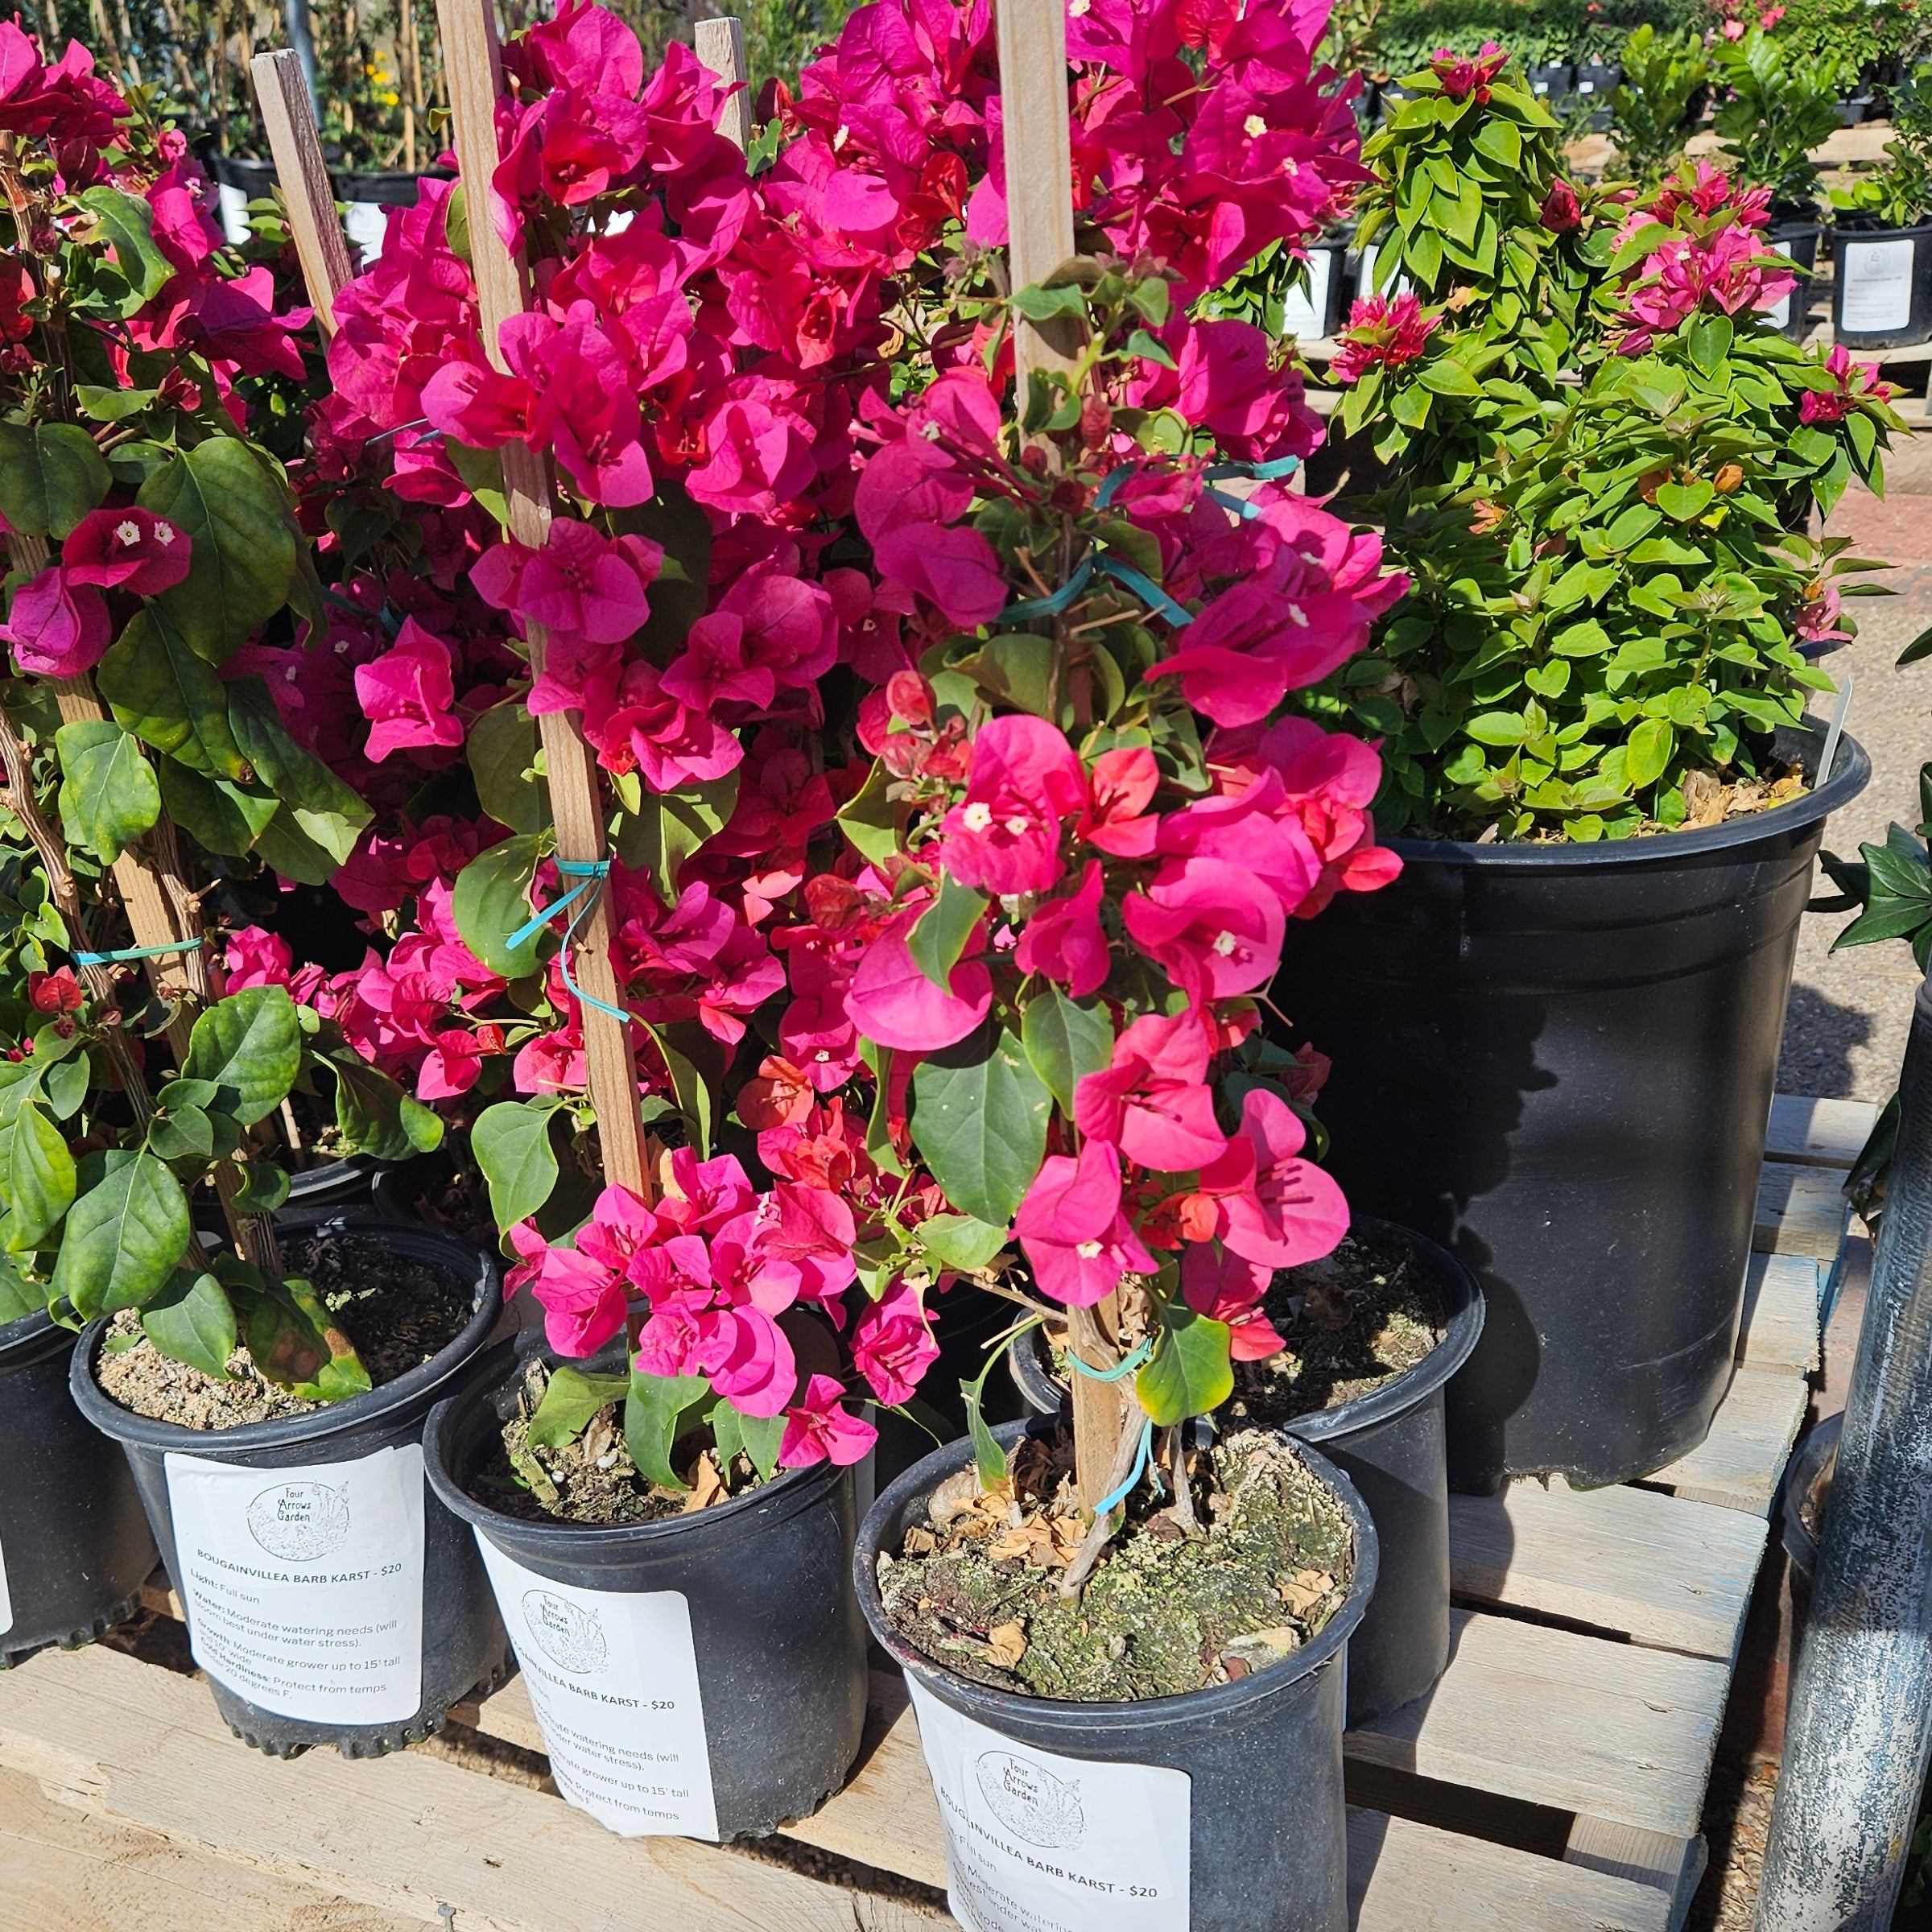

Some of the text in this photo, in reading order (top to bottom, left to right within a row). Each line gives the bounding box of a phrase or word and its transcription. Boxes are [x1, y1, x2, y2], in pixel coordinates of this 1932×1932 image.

[278, 1499, 312, 1510] Arrows
[285, 1488, 303, 1498] Four
[277, 1510, 311, 1522] Garden
[197, 1549, 289, 1582] BOUGAINVILLEA
[294, 1575, 327, 1583] BARB
[331, 1571, 370, 1583] KARST
[381, 1563, 402, 1576] $20
[220, 1584, 237, 1598] Full
[240, 1594, 260, 1604] sun
[193, 1588, 397, 1637] Water: Moderate watering needs (will
[223, 1616, 245, 1632] best
[247, 1628, 279, 1641] under
[282, 1637, 316, 1647] water
[318, 1638, 361, 1649] stress).
[233, 1641, 284, 1665] Moderate
[287, 1659, 328, 1670] grower
[332, 1663, 346, 1672] up
[350, 1662, 361, 1670] to
[364, 1659, 382, 1670] 15'
[384, 1656, 400, 1667] tall
[239, 1675, 281, 1695] degrees
[283, 1690, 292, 1699] F.
[274, 1677, 316, 1691] Protect
[319, 1684, 347, 1694] from
[350, 1683, 386, 1694] temps
[568, 1683, 598, 1700] BARB
[601, 1694, 639, 1709] KARST
[651, 1699, 675, 1711] $20
[571, 1730, 616, 1755] watering
[618, 1748, 654, 1761] needs
[656, 1752, 679, 1763] (will
[573, 1742, 602, 1759] water
[604, 1755, 645, 1771] stress).
[1009, 1757, 1029, 1777] Four
[582, 1767, 689, 1798] grower up to 15' tall
[1003, 1779, 1038, 1806] Garden
[576, 1781, 612, 1805] Protect
[614, 1798, 640, 1814] from
[642, 1807, 679, 1820] temps
[940, 1786, 1023, 1861] BOUGAINVILLEA
[1026, 1856, 1064, 1877] BARB
[1068, 1872, 1116, 1893] KARST
[1129, 1885, 1158, 1898] $20
[978, 1853, 997, 1872] sun
[1020, 1906, 1075, 1932] waterin
